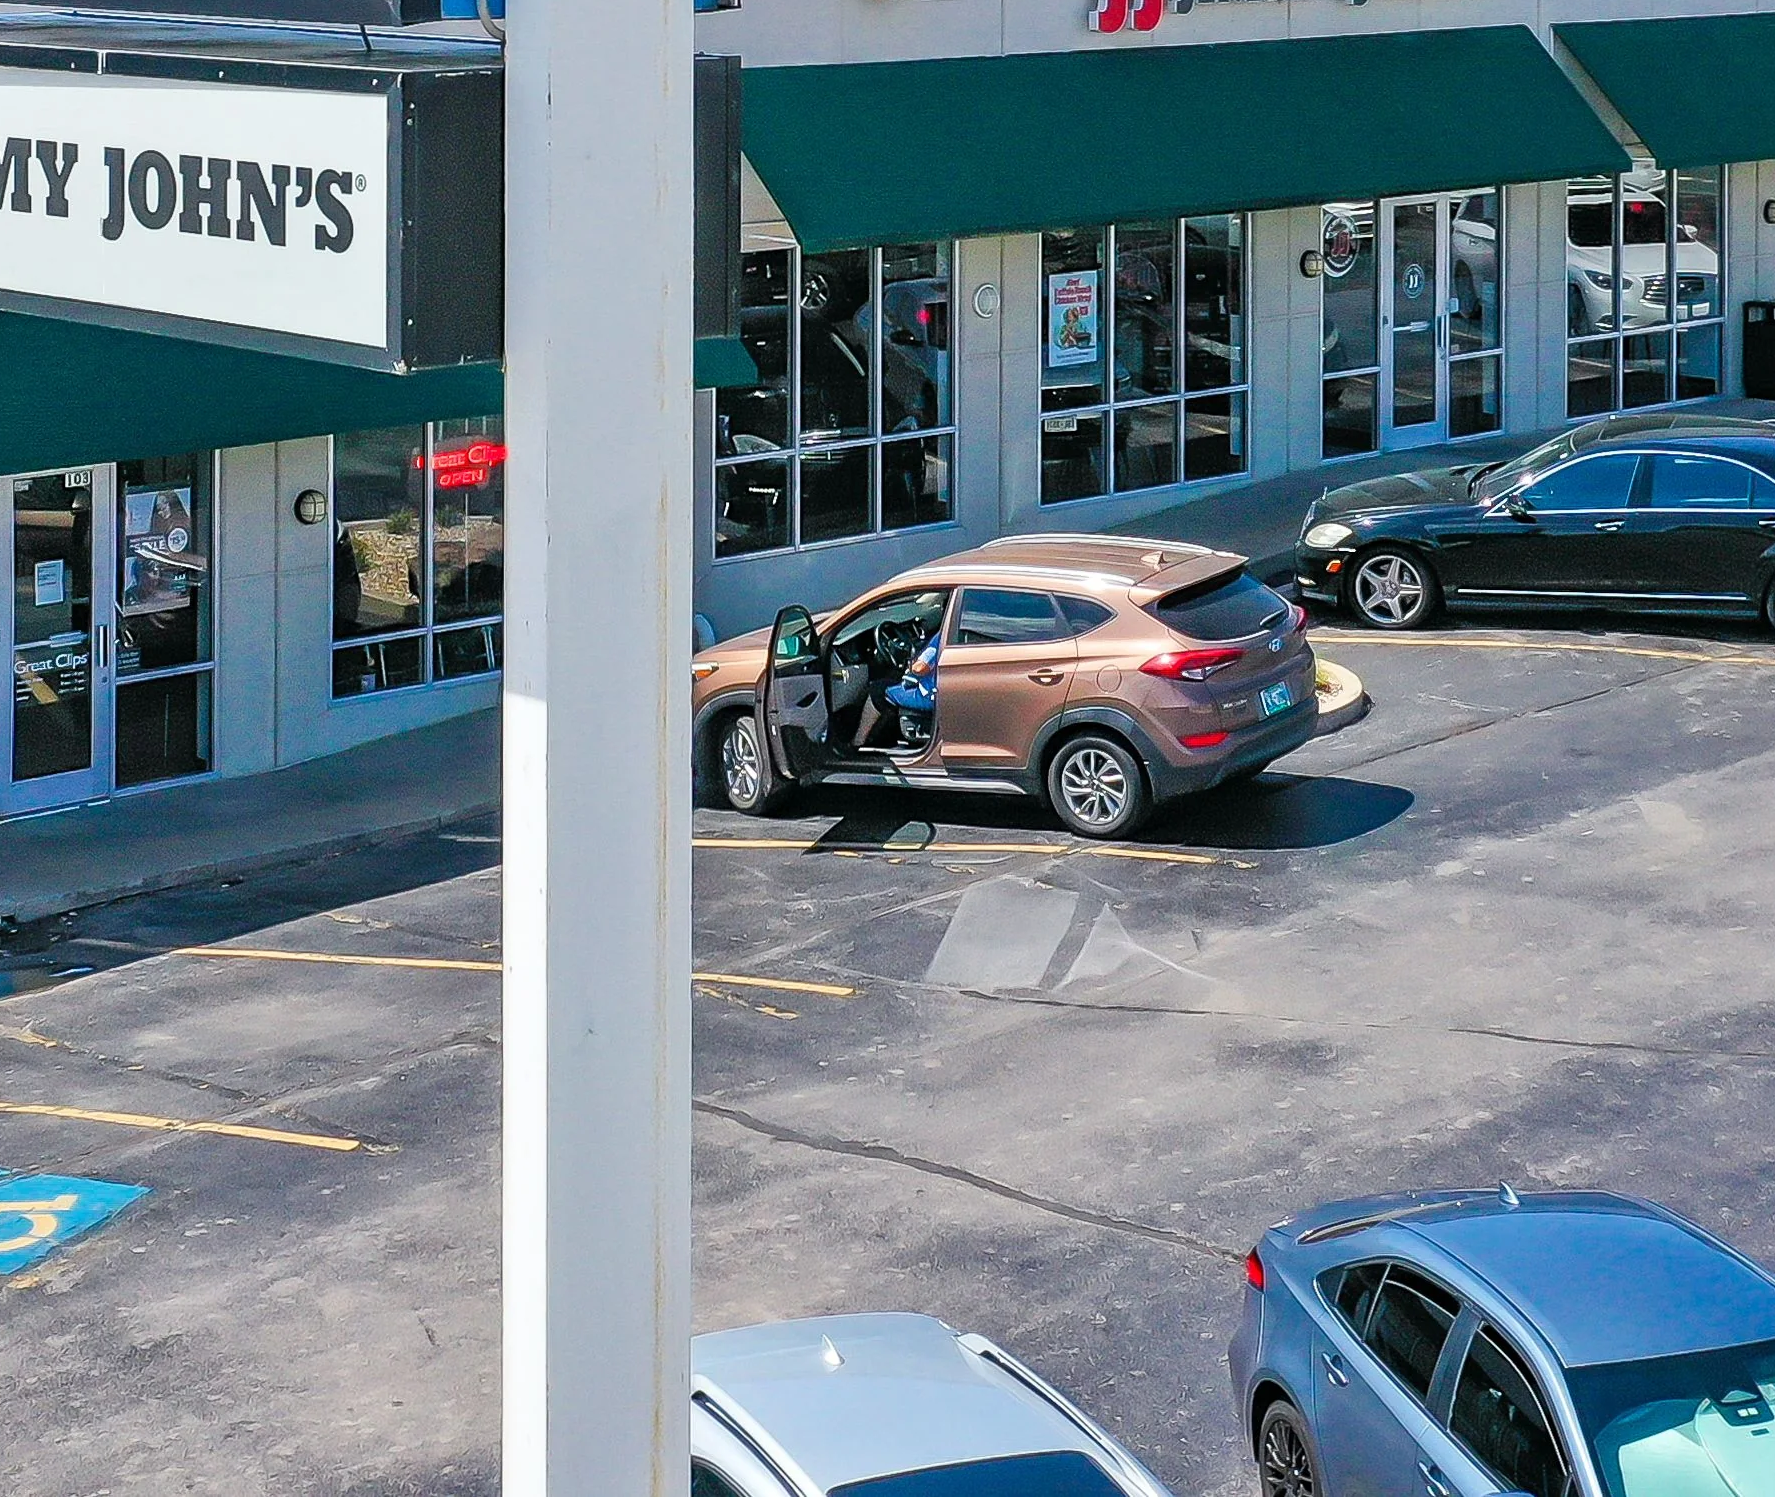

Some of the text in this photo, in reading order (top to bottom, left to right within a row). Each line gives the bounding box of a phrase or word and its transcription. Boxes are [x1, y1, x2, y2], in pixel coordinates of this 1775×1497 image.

[101, 146, 355, 253] JOHN'S
[439, 469, 484, 486] OPEN
[14, 653, 87, 674] Great Clips
